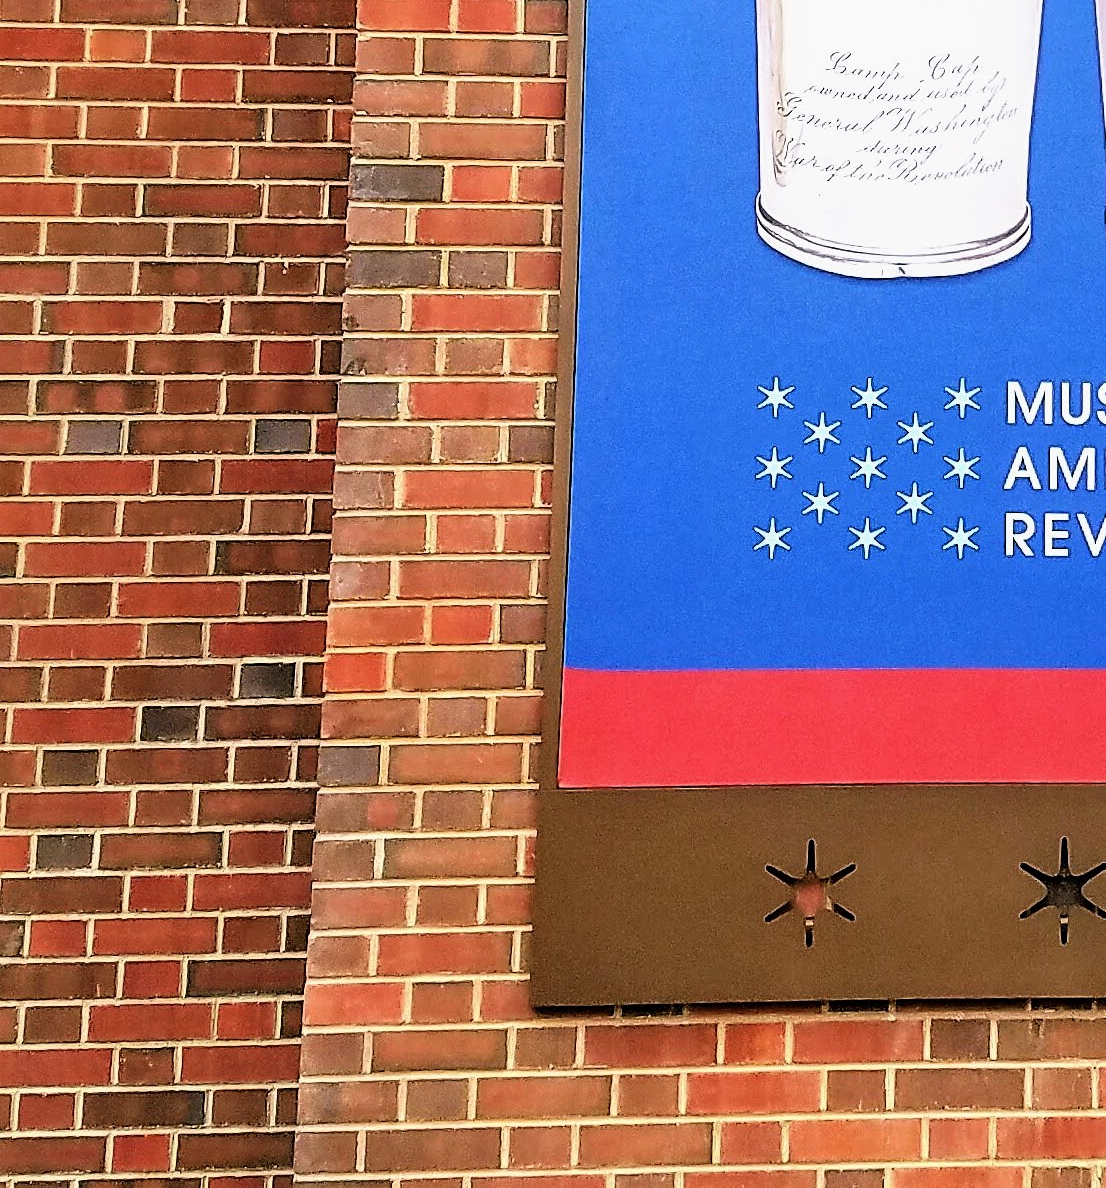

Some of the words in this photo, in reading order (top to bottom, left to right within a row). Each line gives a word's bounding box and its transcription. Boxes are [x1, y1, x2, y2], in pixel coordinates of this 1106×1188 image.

[825, 52, 904, 89] Camp
[920, 54, 980, 87] Cup
[877, 88, 920, 102] and
[777, 92, 884, 132] General
[887, 101, 1019, 144] Washington
[856, 141, 942, 164] during
